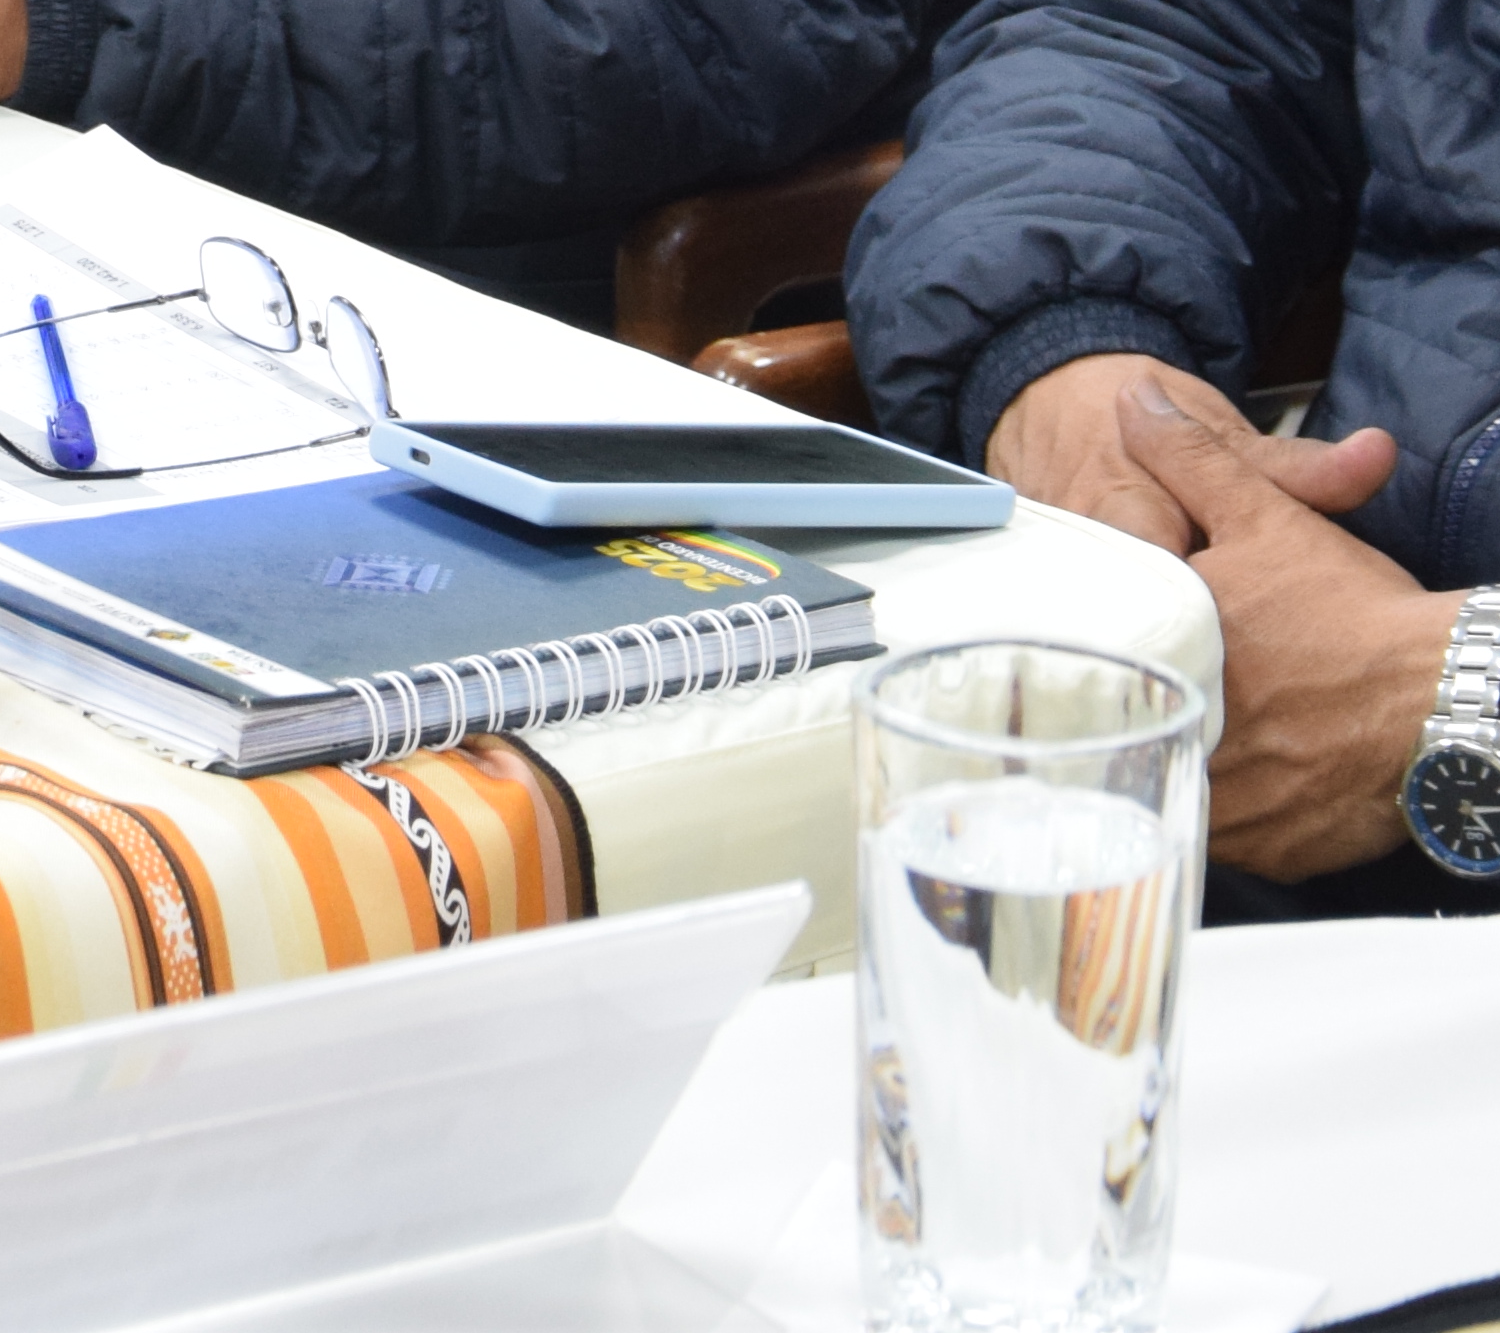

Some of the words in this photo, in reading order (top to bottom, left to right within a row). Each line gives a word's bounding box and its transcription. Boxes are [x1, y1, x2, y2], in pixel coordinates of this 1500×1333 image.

[11, 218, 45, 238] 1.275
[76, 257, 129, 288] 1.442.320
[169, 312, 204, 331] 6.338
[253, 359, 279, 372] 837
[325, 397, 349, 410] 472
[593, 539, 746, 593] 2025
[657, 541, 768, 585] BICENTENARIO
